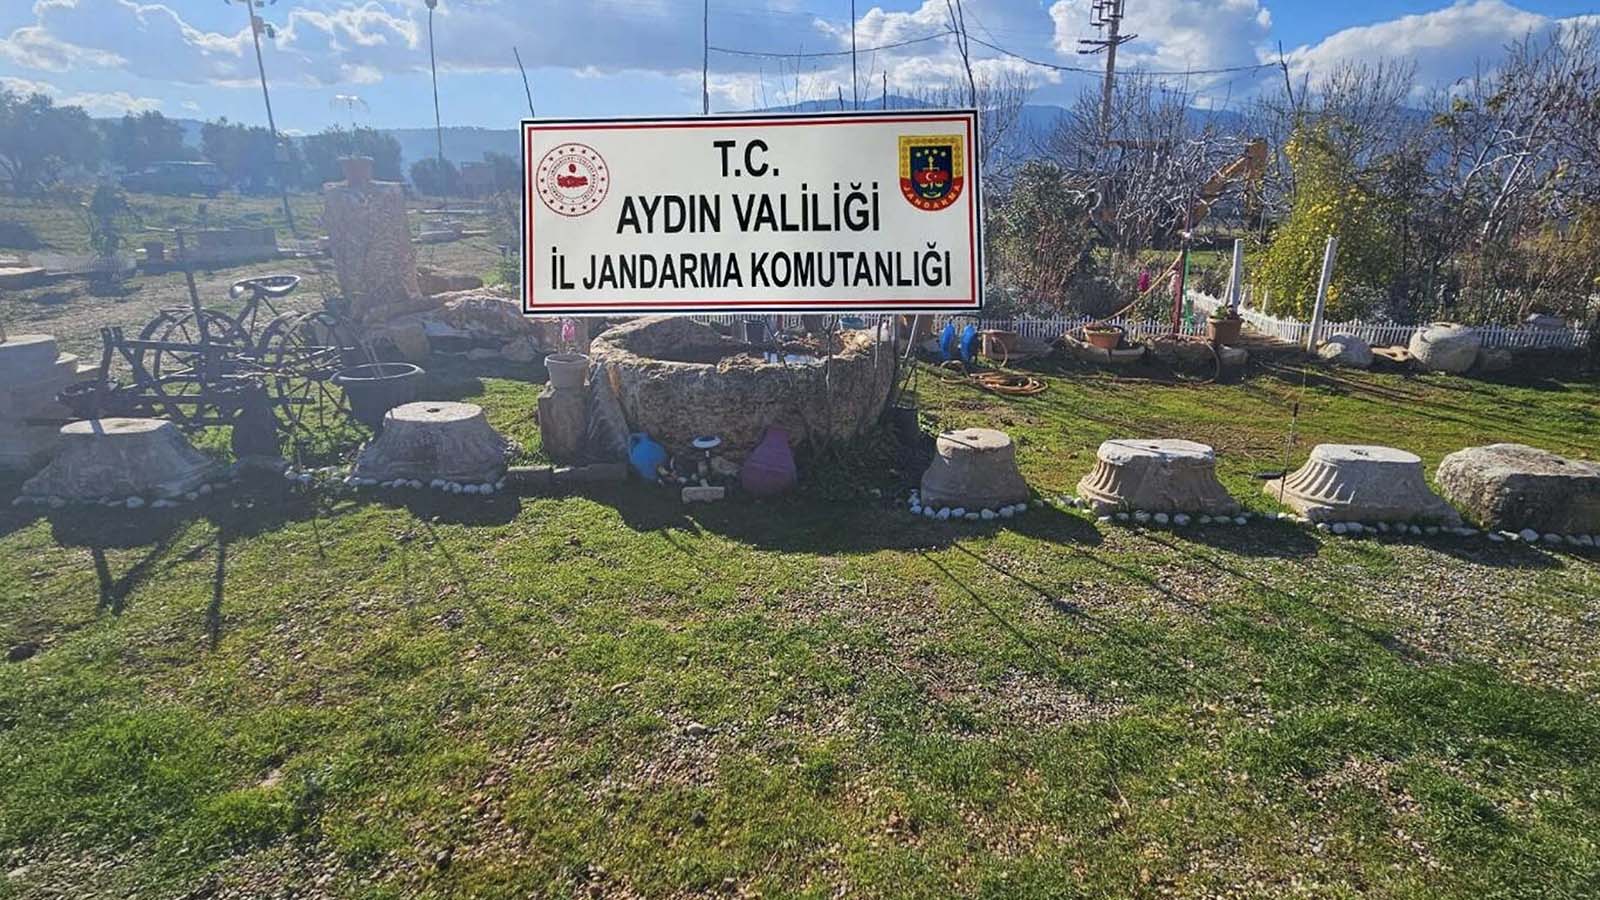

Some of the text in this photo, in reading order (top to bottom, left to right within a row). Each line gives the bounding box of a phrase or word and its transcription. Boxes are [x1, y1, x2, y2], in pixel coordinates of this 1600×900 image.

[713, 139, 780, 178] T.C.
[616, 181, 880, 235] AYDIN VALİLİĞİ
[903, 184, 961, 210] JANDARMA
[551, 241, 952, 290] İL JANDARMA KOMUTANLIĞI
